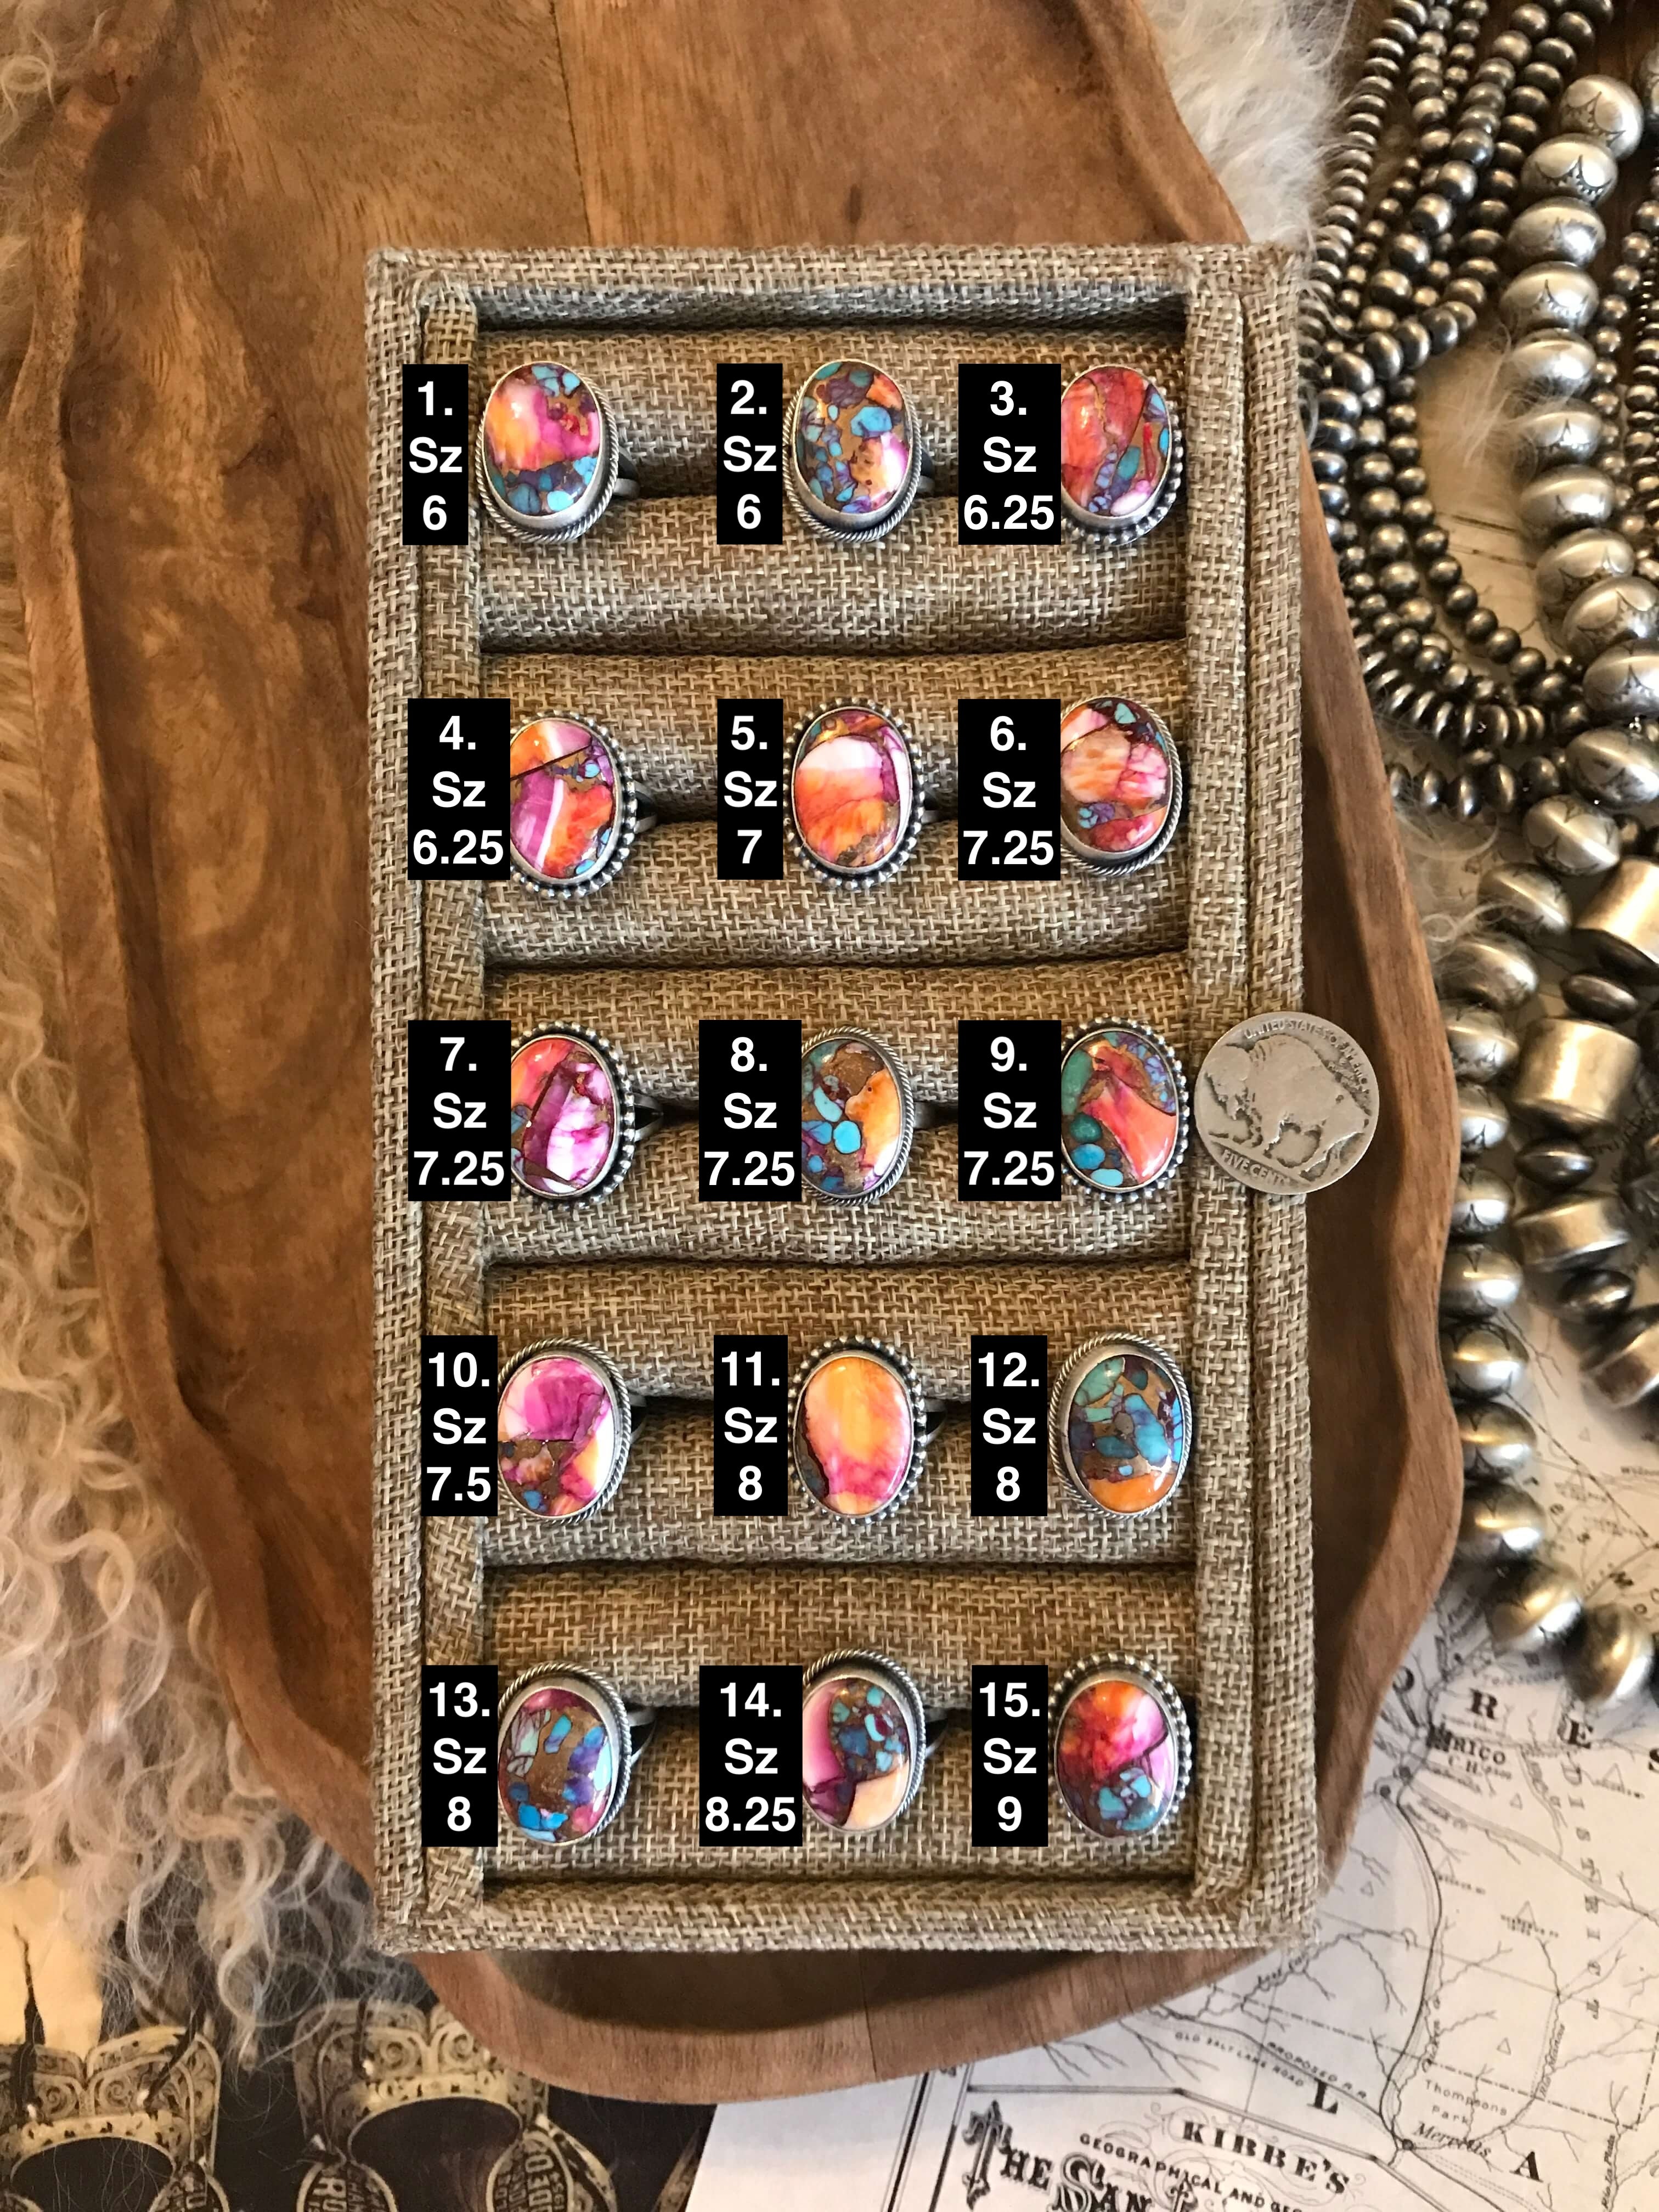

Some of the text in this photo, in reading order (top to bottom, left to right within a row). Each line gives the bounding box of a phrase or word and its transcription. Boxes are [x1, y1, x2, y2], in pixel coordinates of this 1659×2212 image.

[1425, 2079, 1508, 2117] Thompsons
[1431, 2104, 1469, 2125] Park
[1080, 2132, 1222, 2194] GEOGRAPHICAL
[1228, 2187, 1266, 2209] AND
[1183, 2120, 1350, 2194] KIBBE'S
